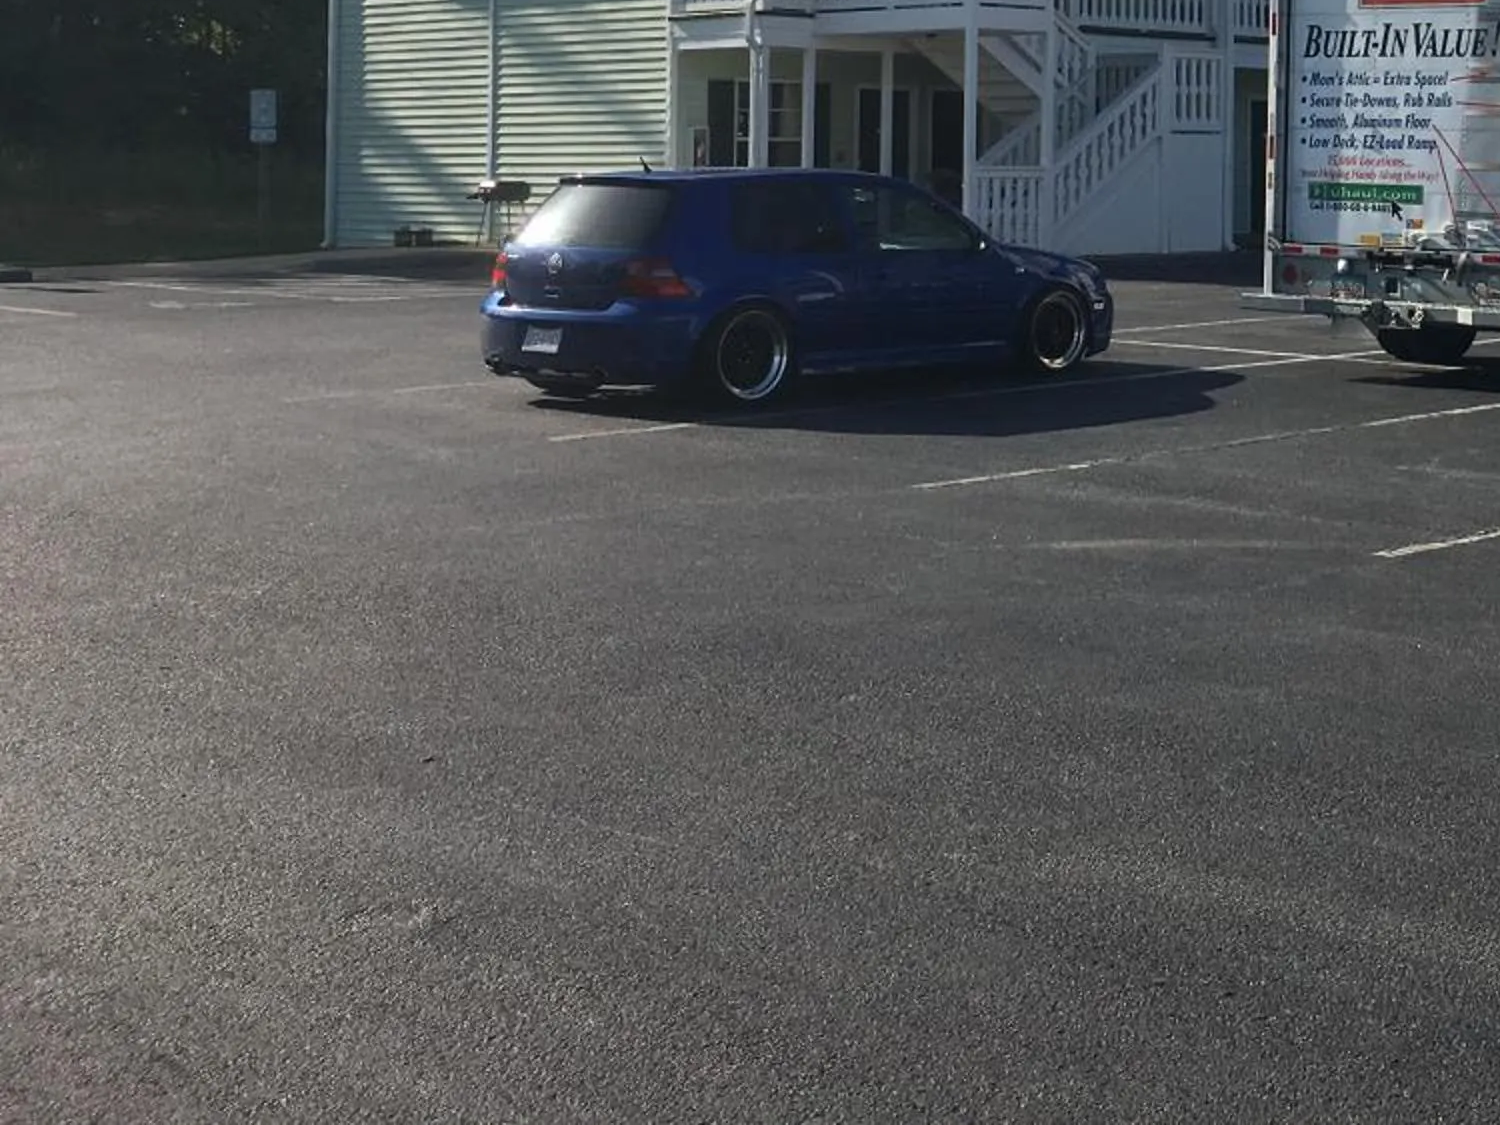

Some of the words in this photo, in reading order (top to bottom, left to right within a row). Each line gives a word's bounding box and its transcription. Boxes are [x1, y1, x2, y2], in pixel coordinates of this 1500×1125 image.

[1304, 23, 1409, 58] BUILT-IN
[1309, 71, 1344, 86] Mom's
[1346, 70, 1371, 86] Attic
[1383, 70, 1412, 86] Extra
[1415, 70, 1449, 89] Space!
[1309, 92, 1341, 108] Secure
[1403, 92, 1424, 108] Rub
[1426, 91, 1453, 107] Rails
[1309, 113, 1349, 129] Smooth,
[1353, 113, 1403, 129] Aluminum
[1405, 113, 1432, 129] Floor
[1309, 135, 1332, 149] Low
[1363, 134, 1404, 150] EZ-Load
[1407, 135, 1437, 154] Ramp
